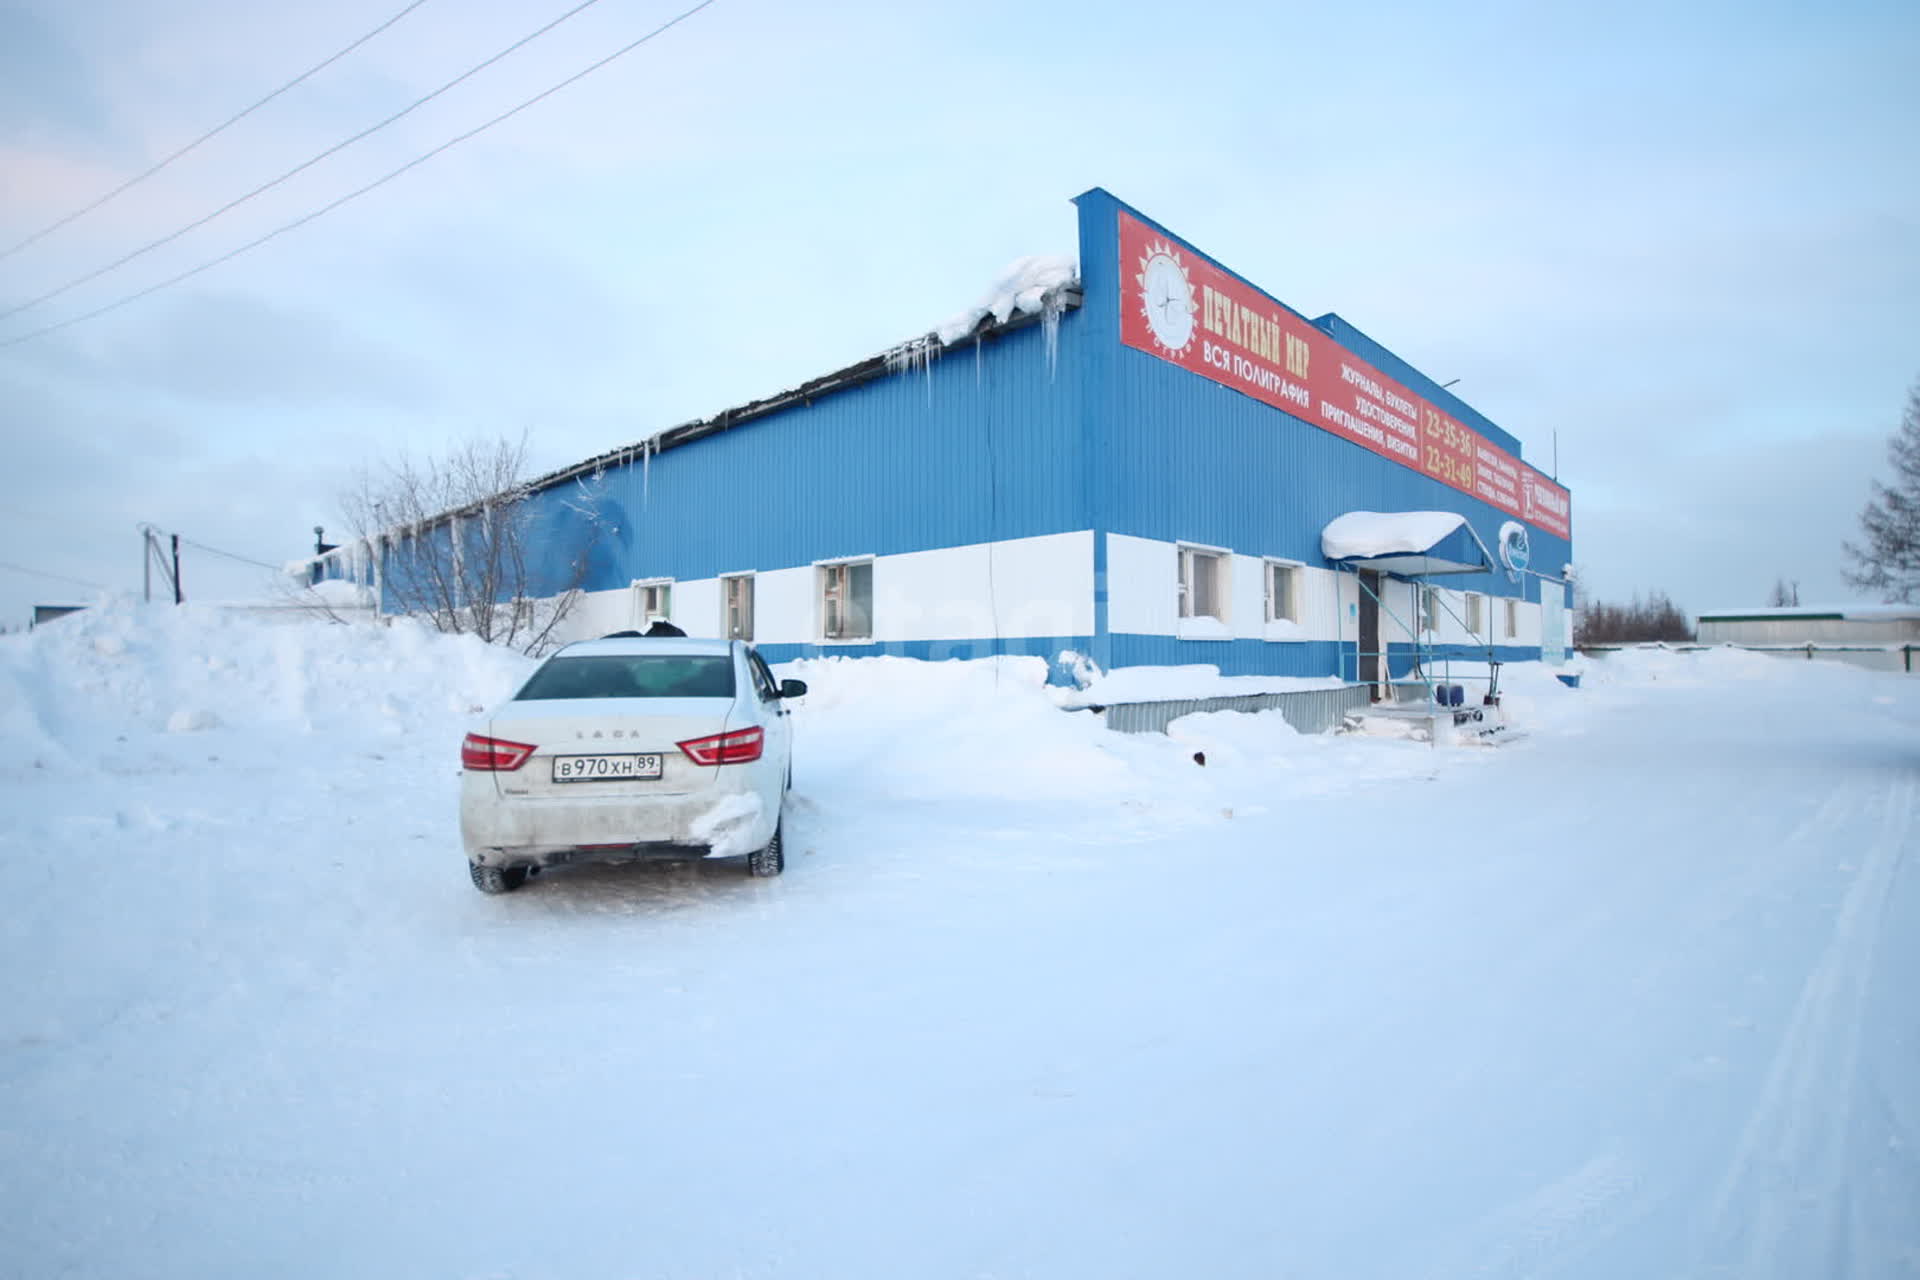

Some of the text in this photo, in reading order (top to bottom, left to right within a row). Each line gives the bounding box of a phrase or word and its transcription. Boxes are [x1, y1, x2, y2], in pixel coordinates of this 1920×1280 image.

[1202, 285, 1310, 380] ПЕЧАТНЫЙ МИР
[1203, 340, 1310, 409] ВСЯ ПОЛИГРАФИЯ
[1425, 409, 1472, 458] 23-35-36
[1425, 445, 1473, 489] 23-31-49
[637, 756, 655, 769] 89
